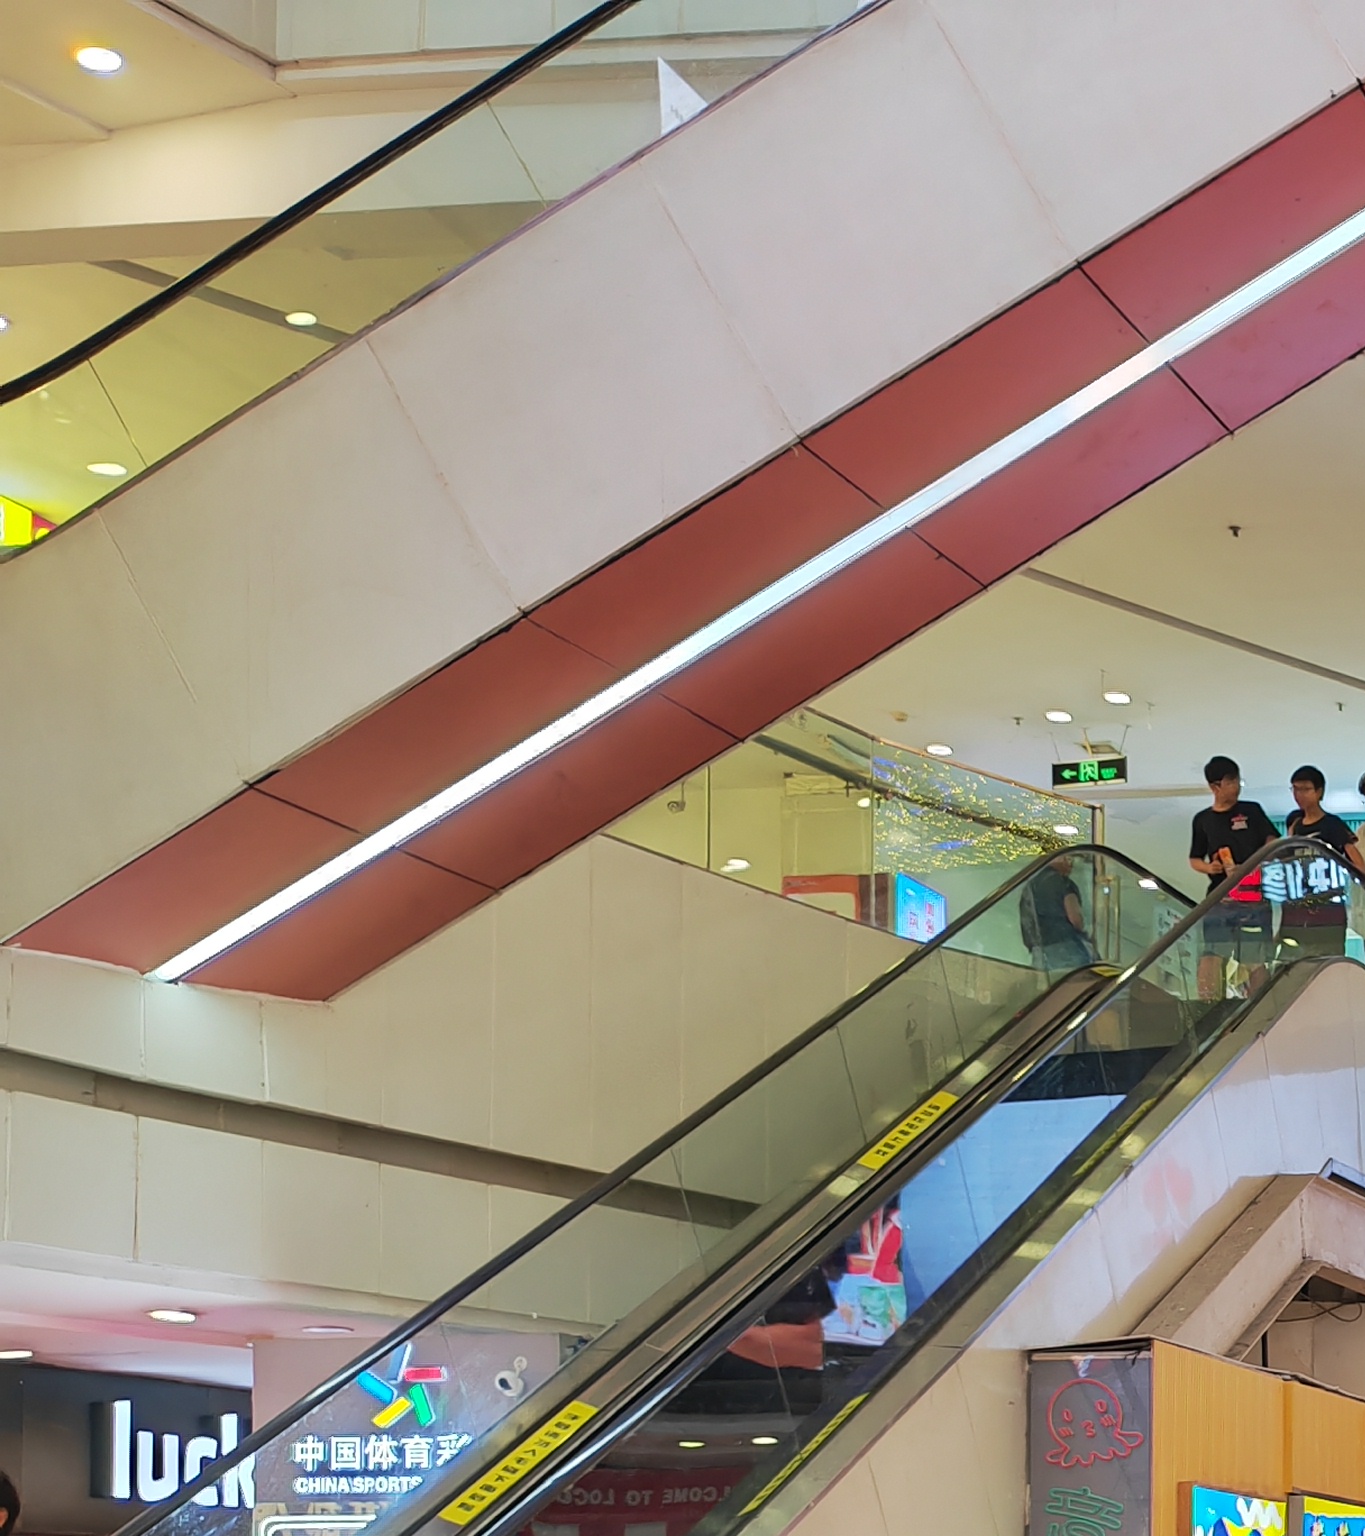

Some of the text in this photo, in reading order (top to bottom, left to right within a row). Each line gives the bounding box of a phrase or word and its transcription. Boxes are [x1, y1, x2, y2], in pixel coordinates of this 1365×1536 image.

[293, 1434, 473, 1472] 中国体育彩
[294, 1476, 349, 1494] CHINA
